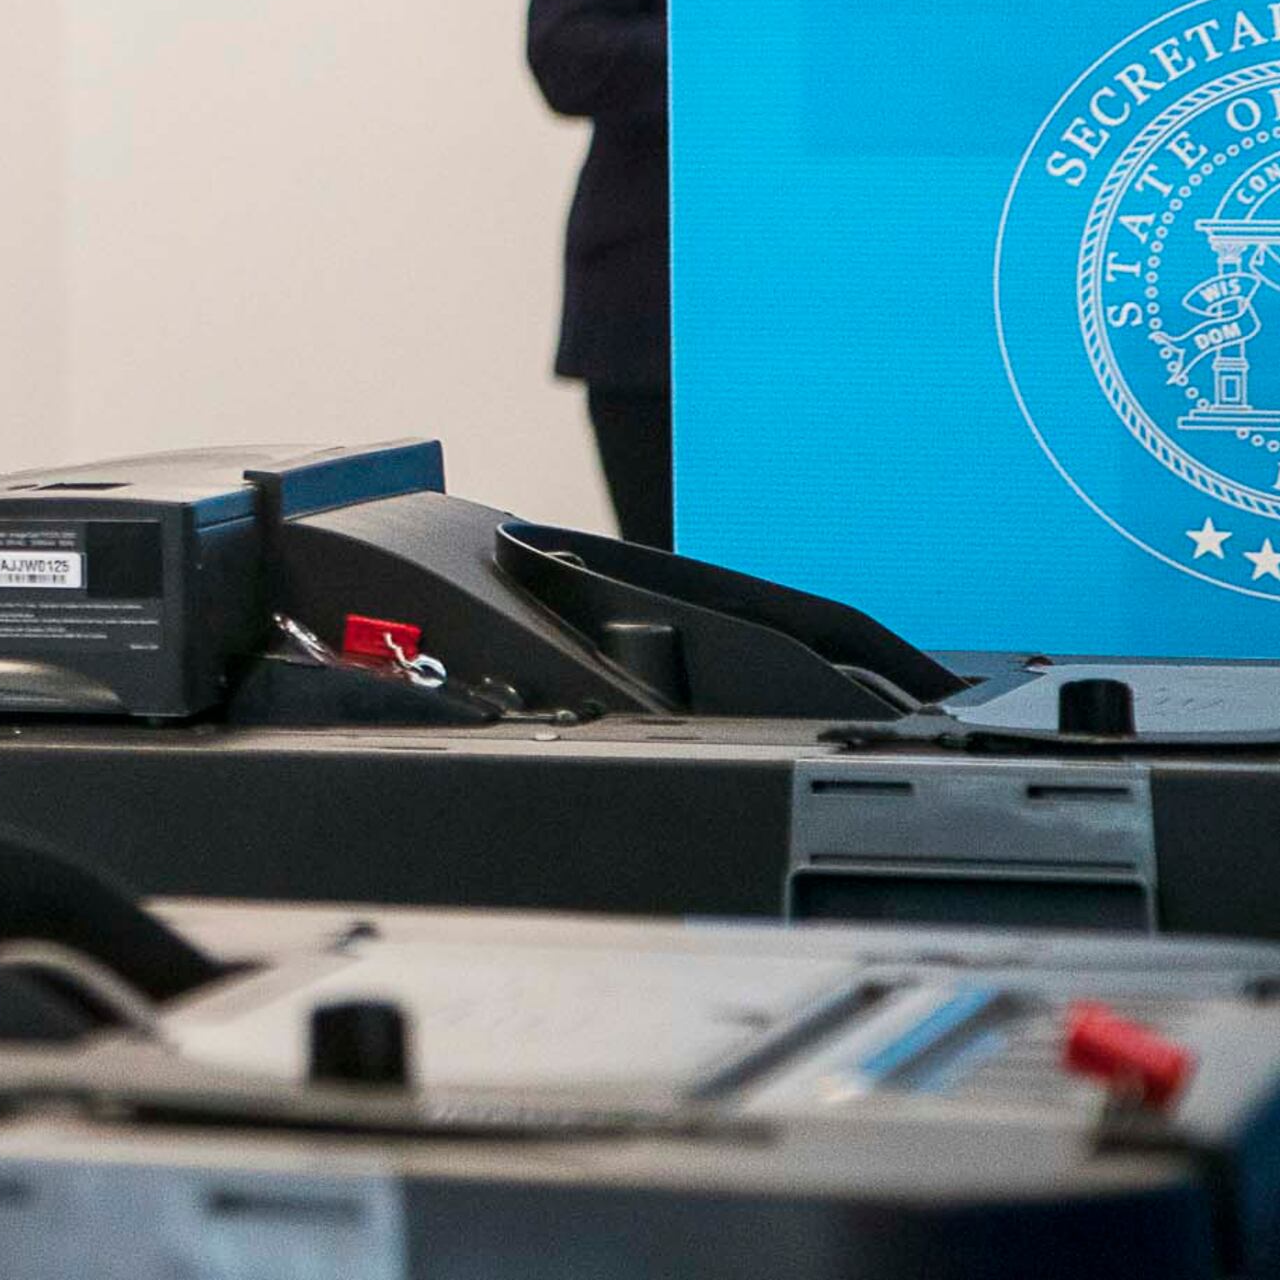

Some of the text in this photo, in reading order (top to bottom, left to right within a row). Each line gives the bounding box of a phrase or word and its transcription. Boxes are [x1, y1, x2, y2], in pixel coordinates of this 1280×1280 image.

[1237, 162, 1280, 204] CON
[1105, 131, 1209, 328] STATE
[1200, 278, 1241, 303] WIS
[1194, 322, 1241, 350] DOM
